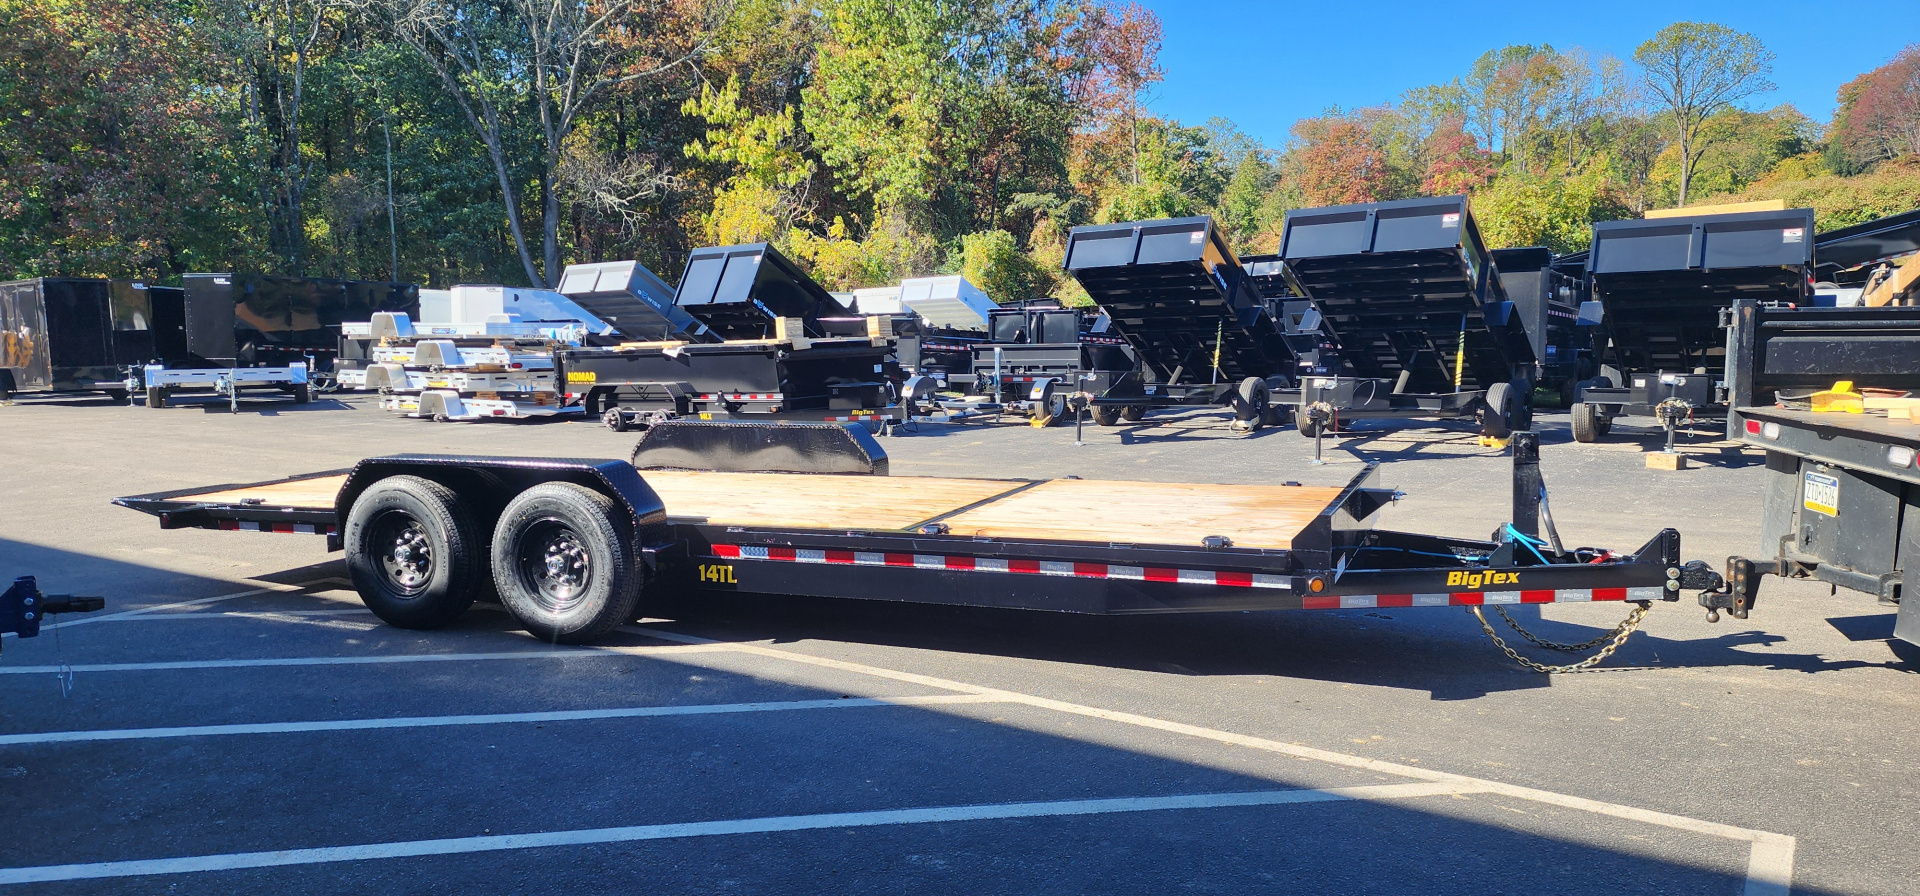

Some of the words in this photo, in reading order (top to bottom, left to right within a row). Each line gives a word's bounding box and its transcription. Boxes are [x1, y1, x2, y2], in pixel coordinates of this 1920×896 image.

[567, 372, 596, 382] NOMAD
[699, 564, 738, 583] 14TL
[1446, 570, 1520, 589] BigTex
